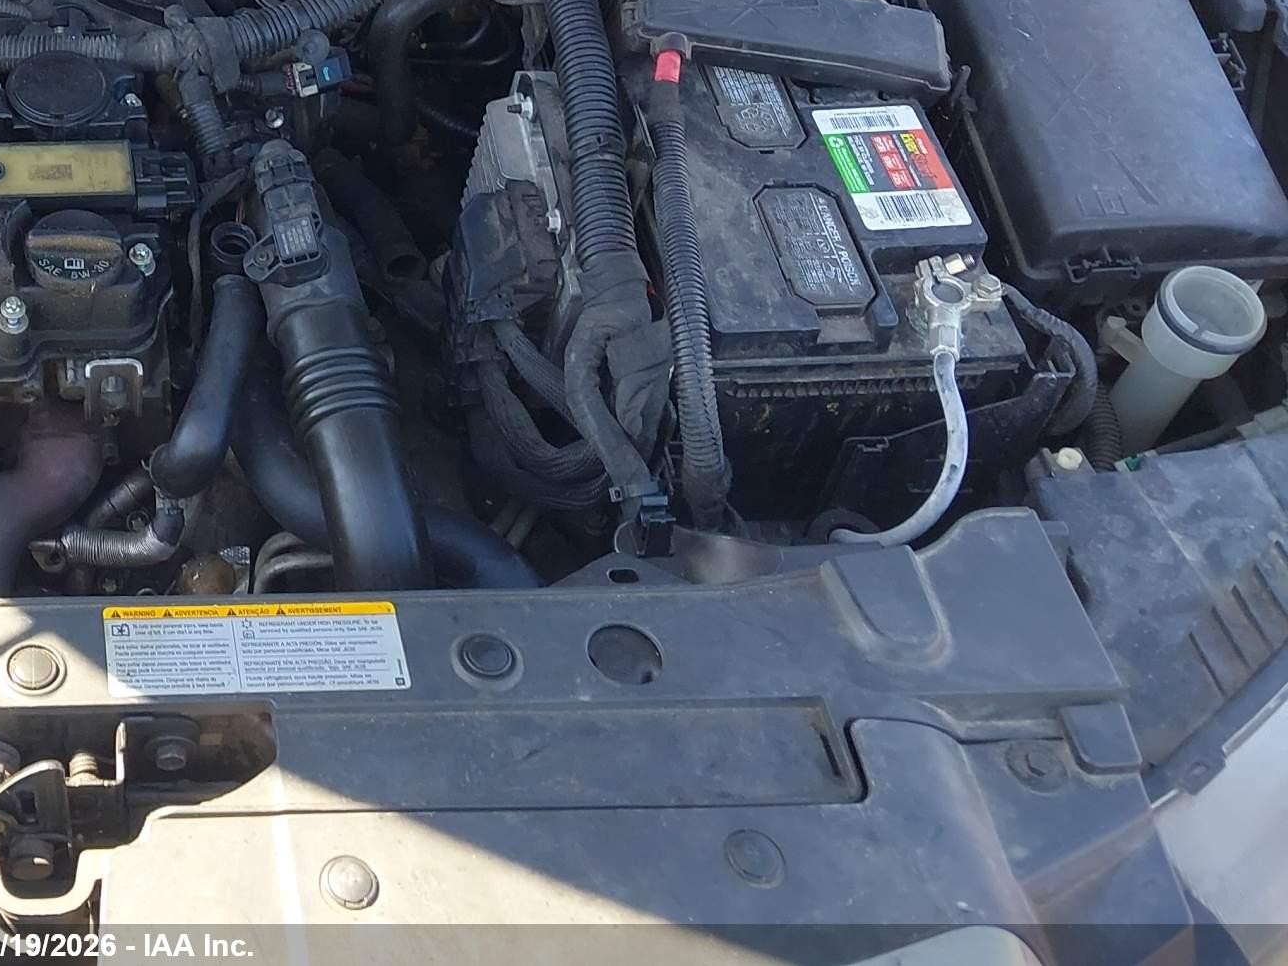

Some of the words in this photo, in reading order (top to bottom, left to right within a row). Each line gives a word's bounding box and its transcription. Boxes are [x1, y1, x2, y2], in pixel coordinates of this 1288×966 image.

[38, 258, 63, 276] SAE
[122, 609, 156, 618] WARNING
[175, 609, 219, 617] ADVERTENCIA
[238, 607, 270, 617] ATENÇÃO
[288, 606, 342, 615] AVERTISSEMENT
